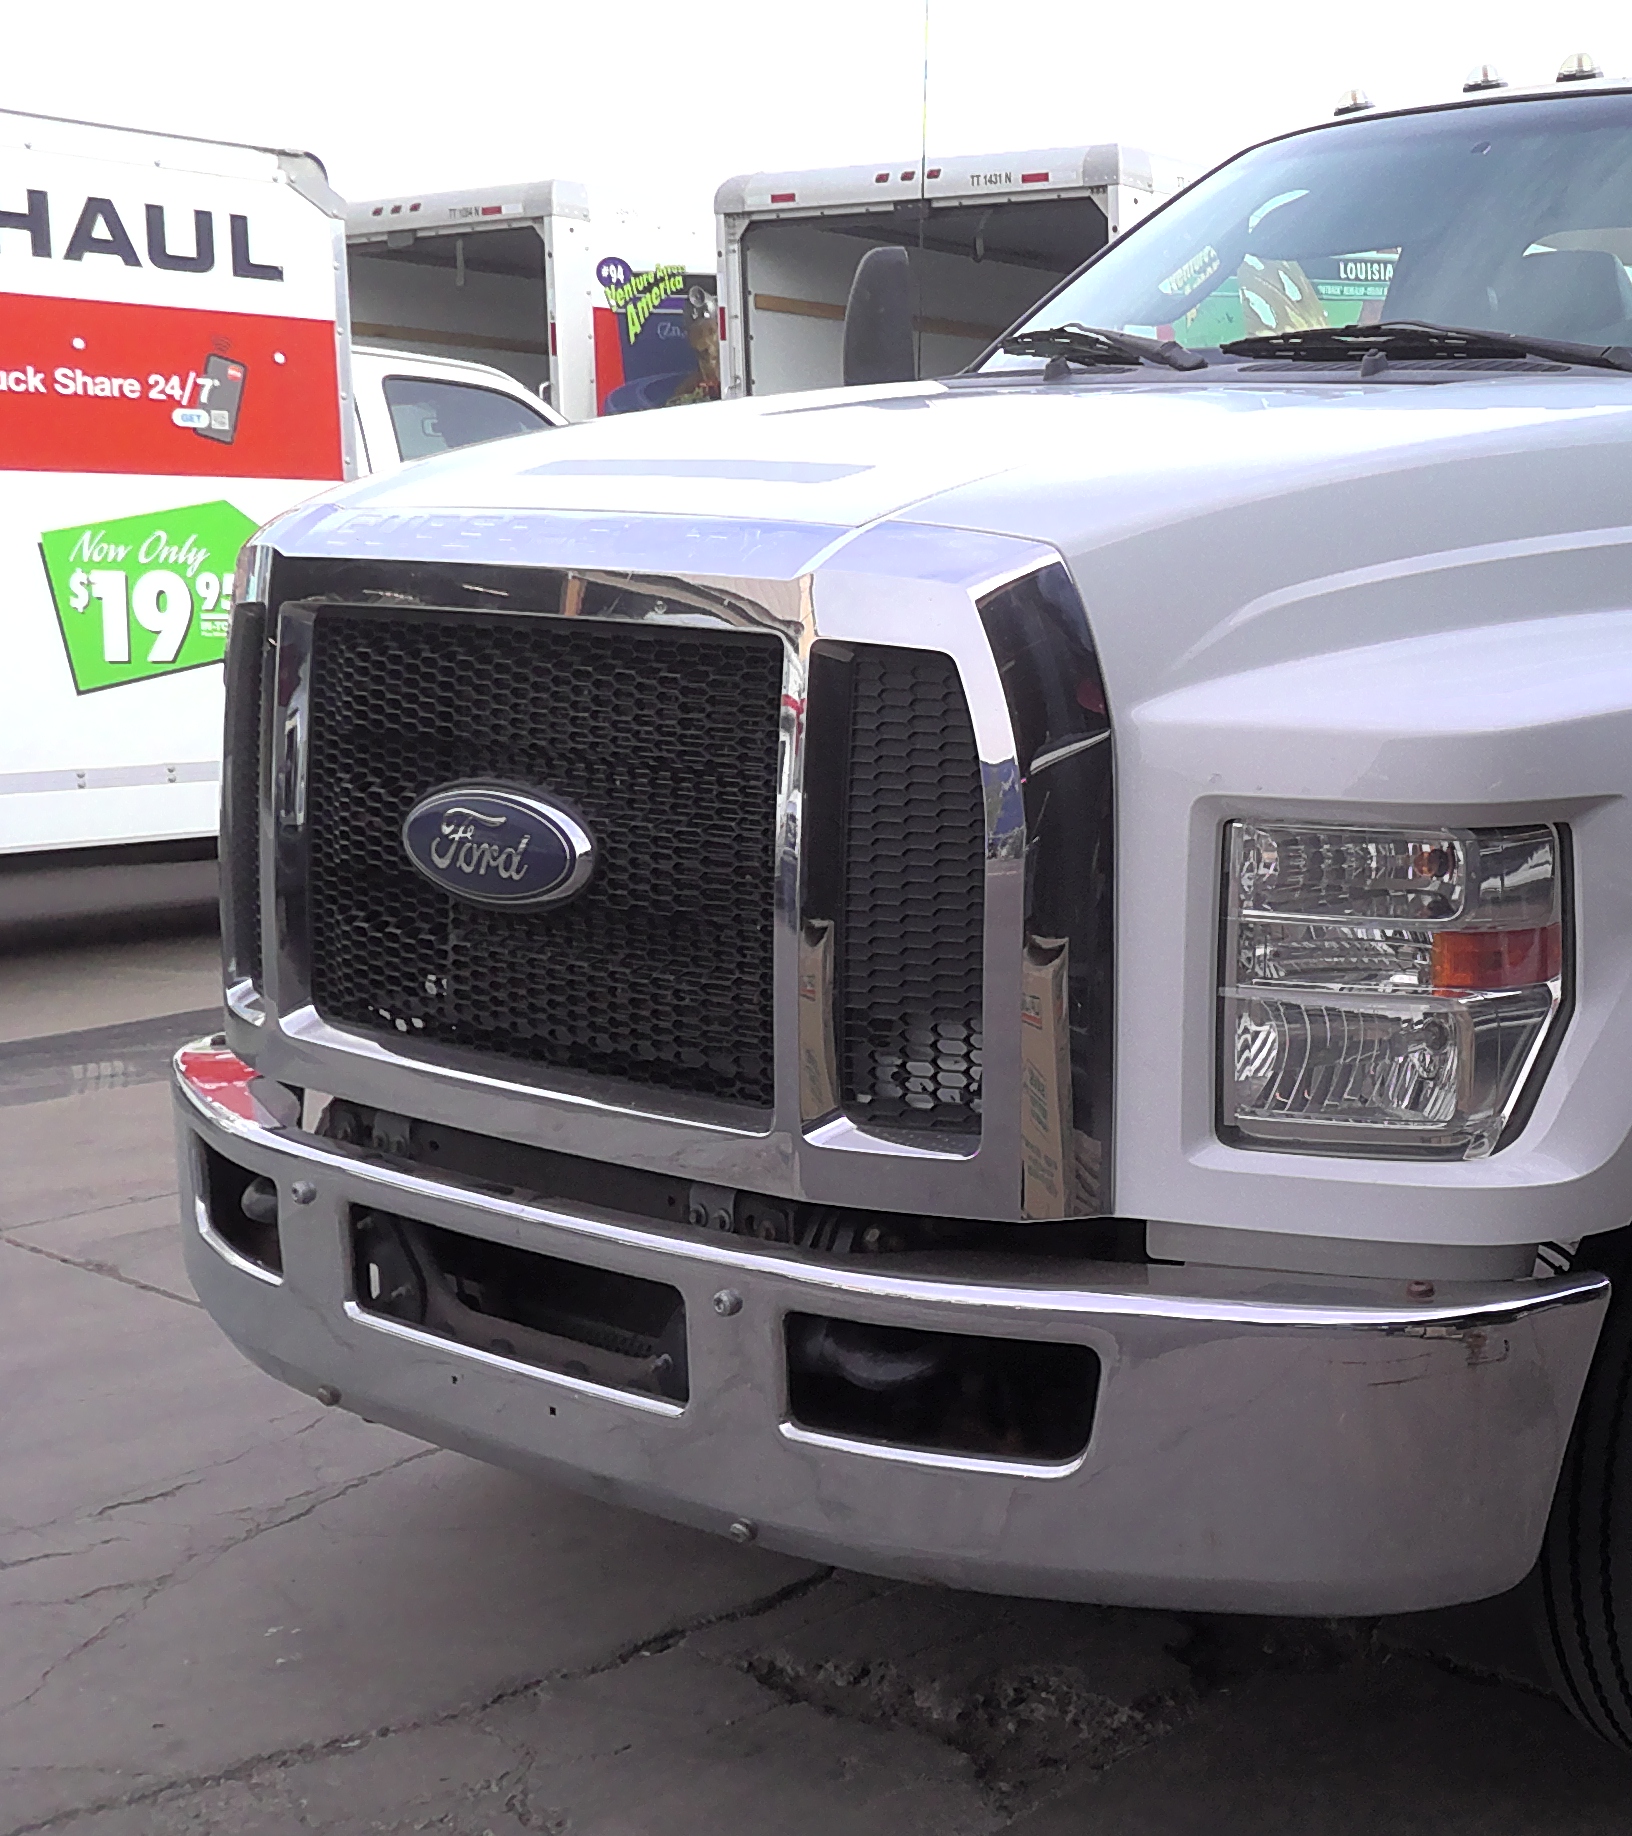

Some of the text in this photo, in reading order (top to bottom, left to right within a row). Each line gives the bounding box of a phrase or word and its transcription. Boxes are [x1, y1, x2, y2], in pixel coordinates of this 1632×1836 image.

[970, 175, 981, 186] TT
[1005, 172, 1012, 184] N
[0, 188, 284, 282] HAUL
[601, 263, 625, 284] #94
[604, 270, 655, 313] Venture
[626, 275, 685, 346] America
[53, 367, 141, 398] Share
[68, 529, 211, 578] Now Only
[430, 807, 531, 881] Ford
